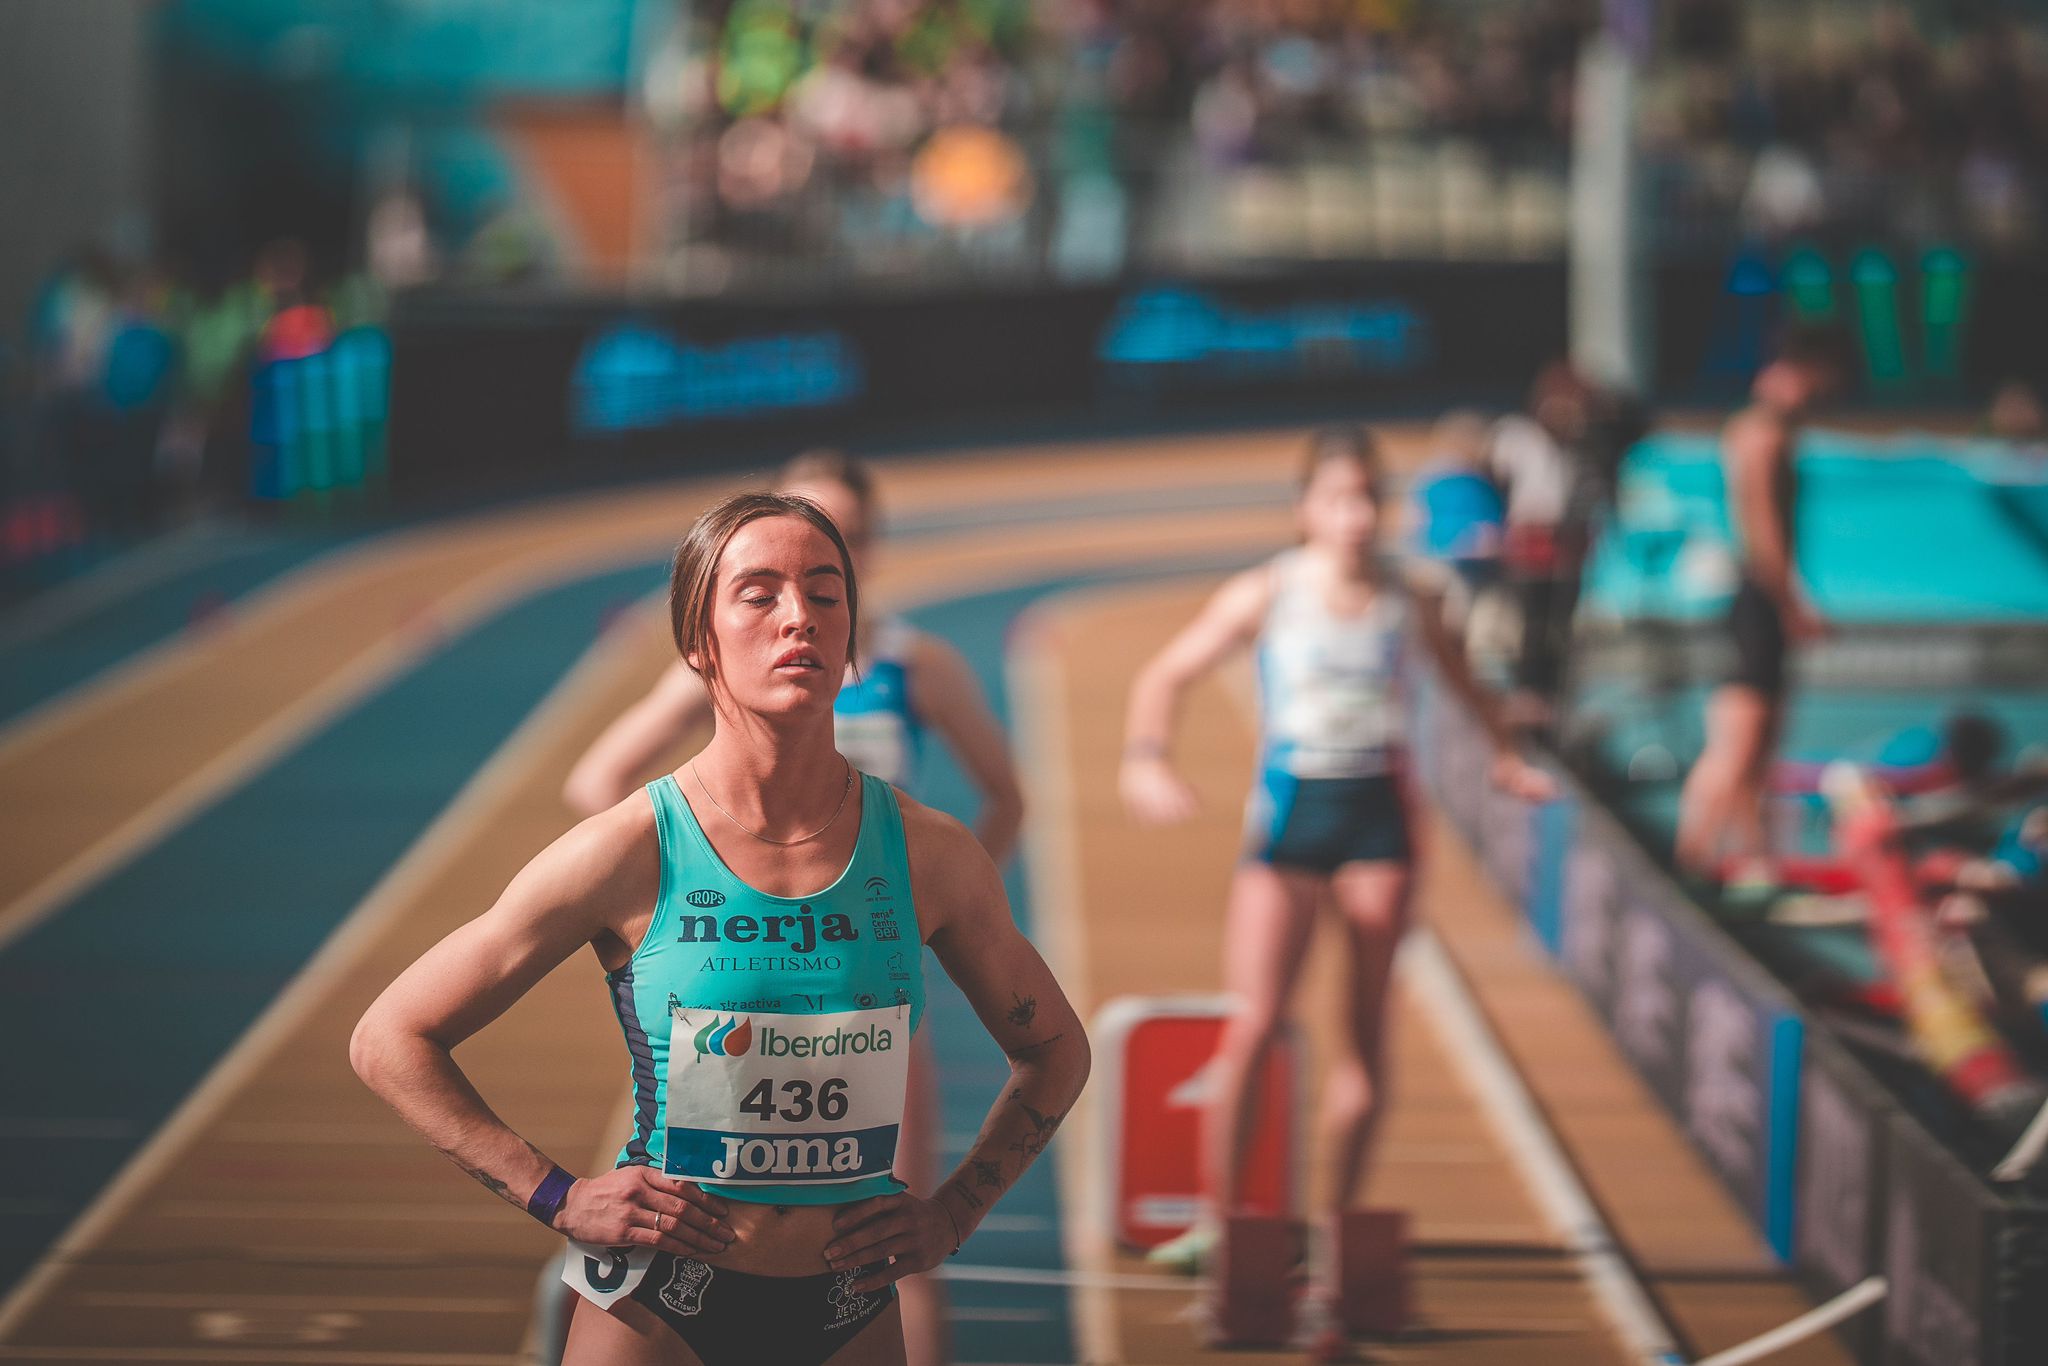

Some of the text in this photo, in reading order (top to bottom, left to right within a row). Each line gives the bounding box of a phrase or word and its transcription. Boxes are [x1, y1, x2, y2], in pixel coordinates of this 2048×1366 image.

[688, 890, 724, 905] TROPS
[677, 904, 859, 953] nerja
[872, 920, 897, 928] Centro
[700, 956, 841, 971] ATLETISMO
[740, 998, 781, 1010] activa
[760, 1024, 892, 1058] Iberdrola
[740, 1078, 849, 1122] 436
[712, 1136, 863, 1178] Joma
[683, 1263, 704, 1276] NERJA
[687, 1259, 704, 1270] CLUB
[663, 1292, 697, 1312] ATLETISMO
[836, 1295, 869, 1319] NERJA
